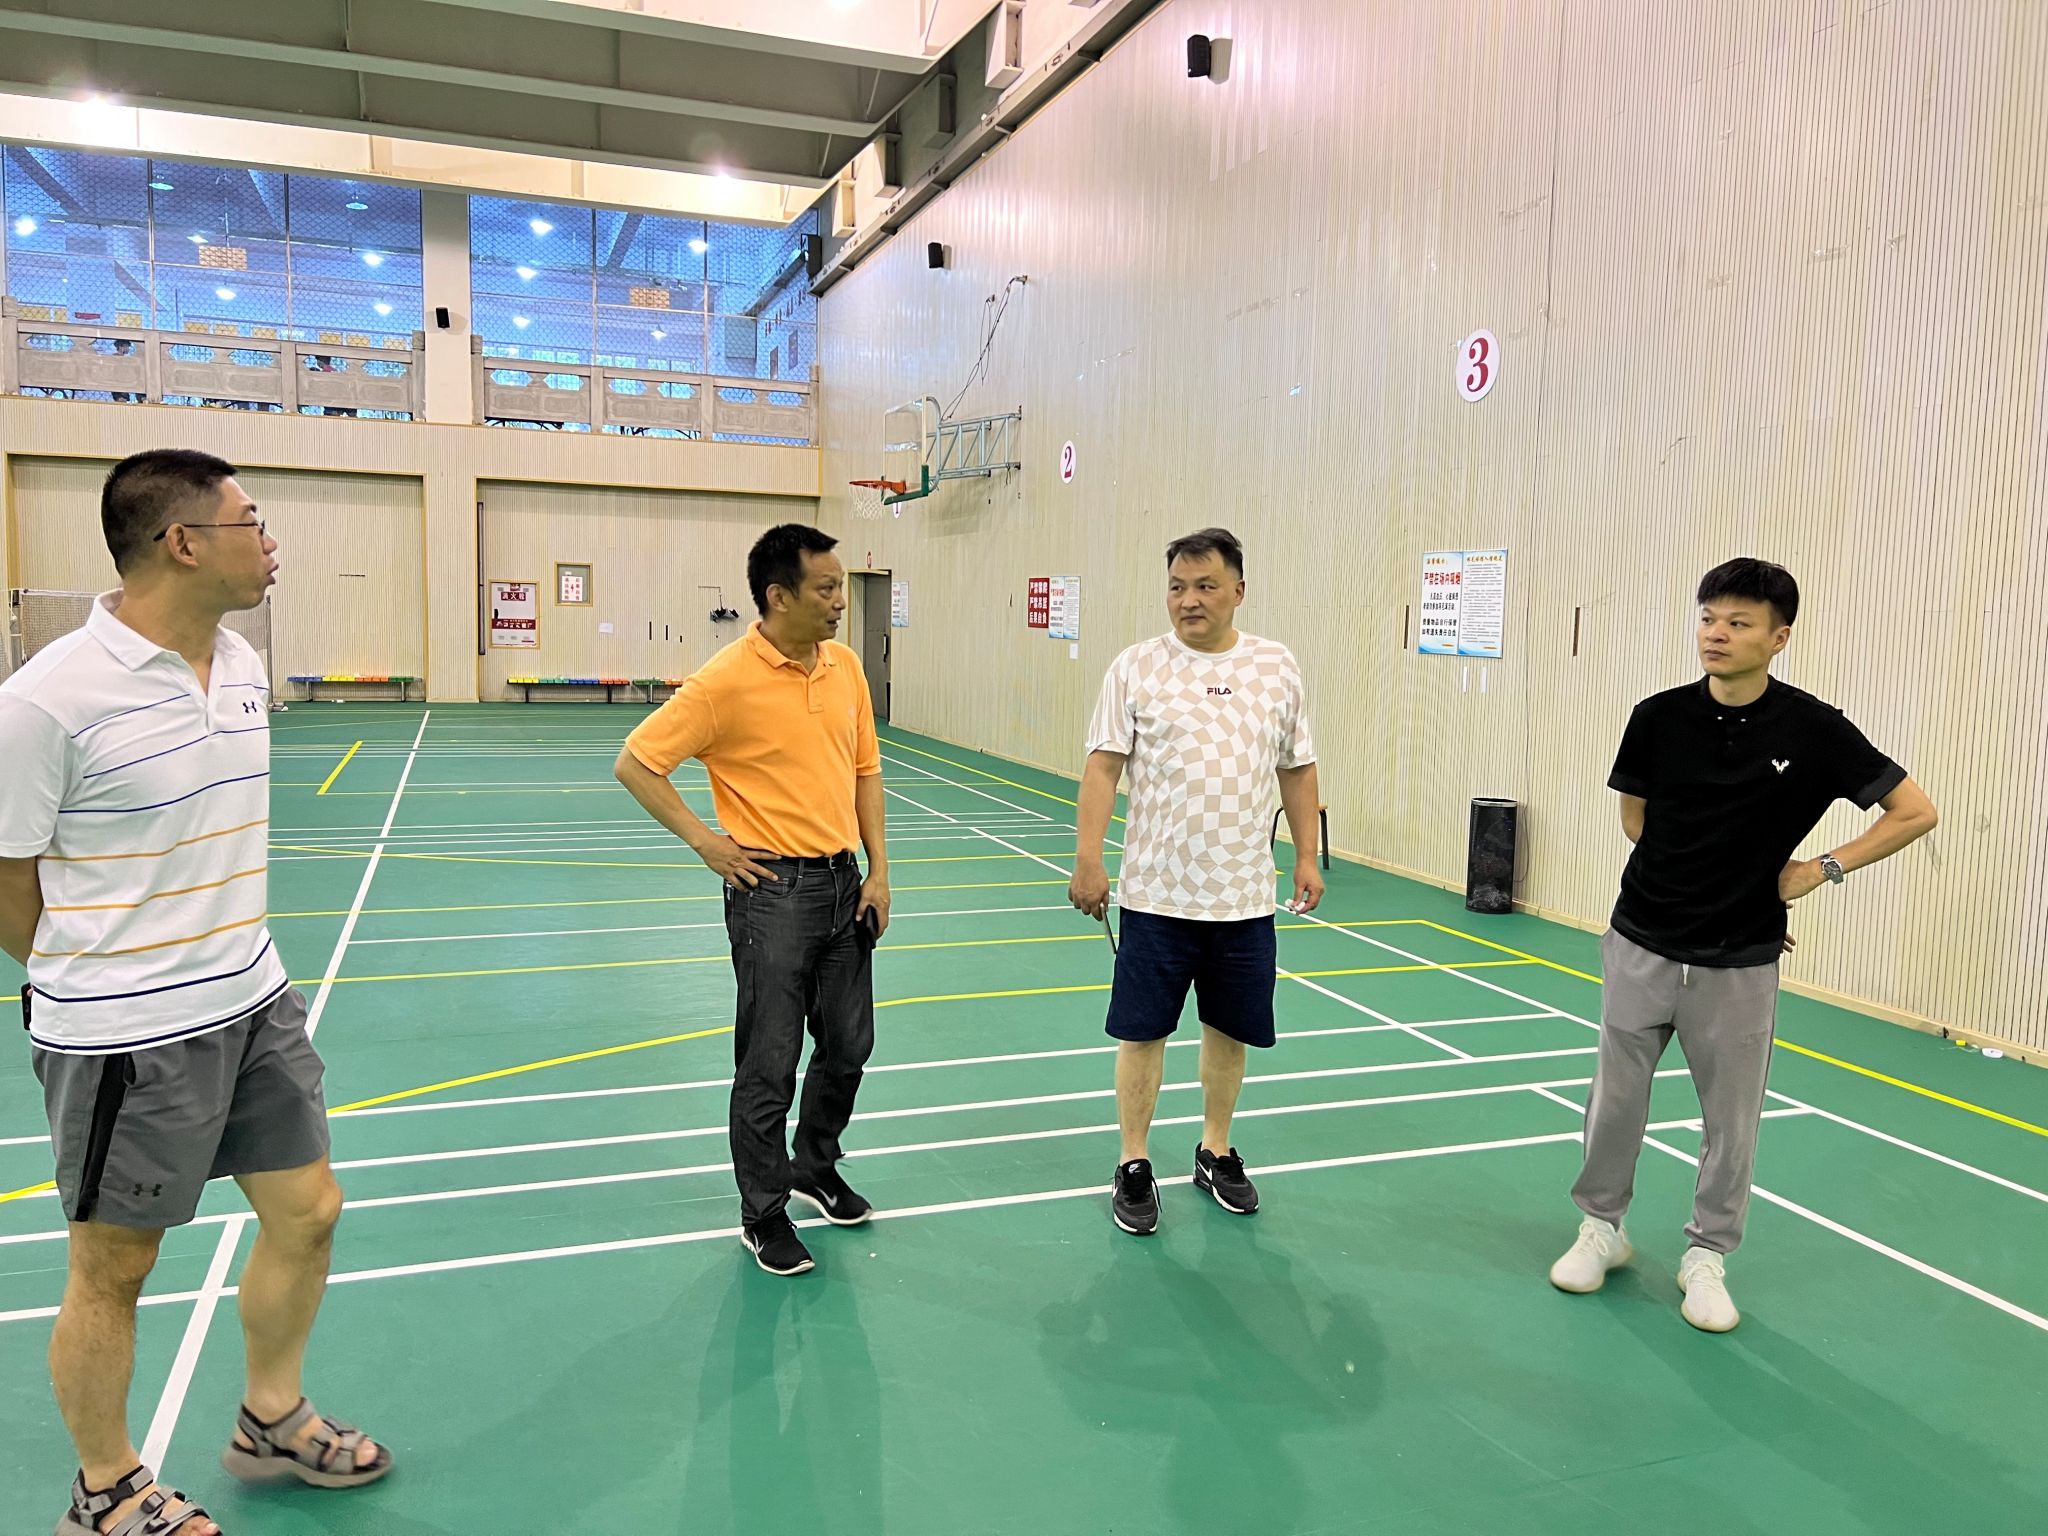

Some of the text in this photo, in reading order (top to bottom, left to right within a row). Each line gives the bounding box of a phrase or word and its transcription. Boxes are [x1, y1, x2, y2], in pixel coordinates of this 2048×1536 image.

[1466, 337, 1489, 392] 3
[1064, 445, 1072, 478] 2
[1207, 687, 1232, 695] FILA
